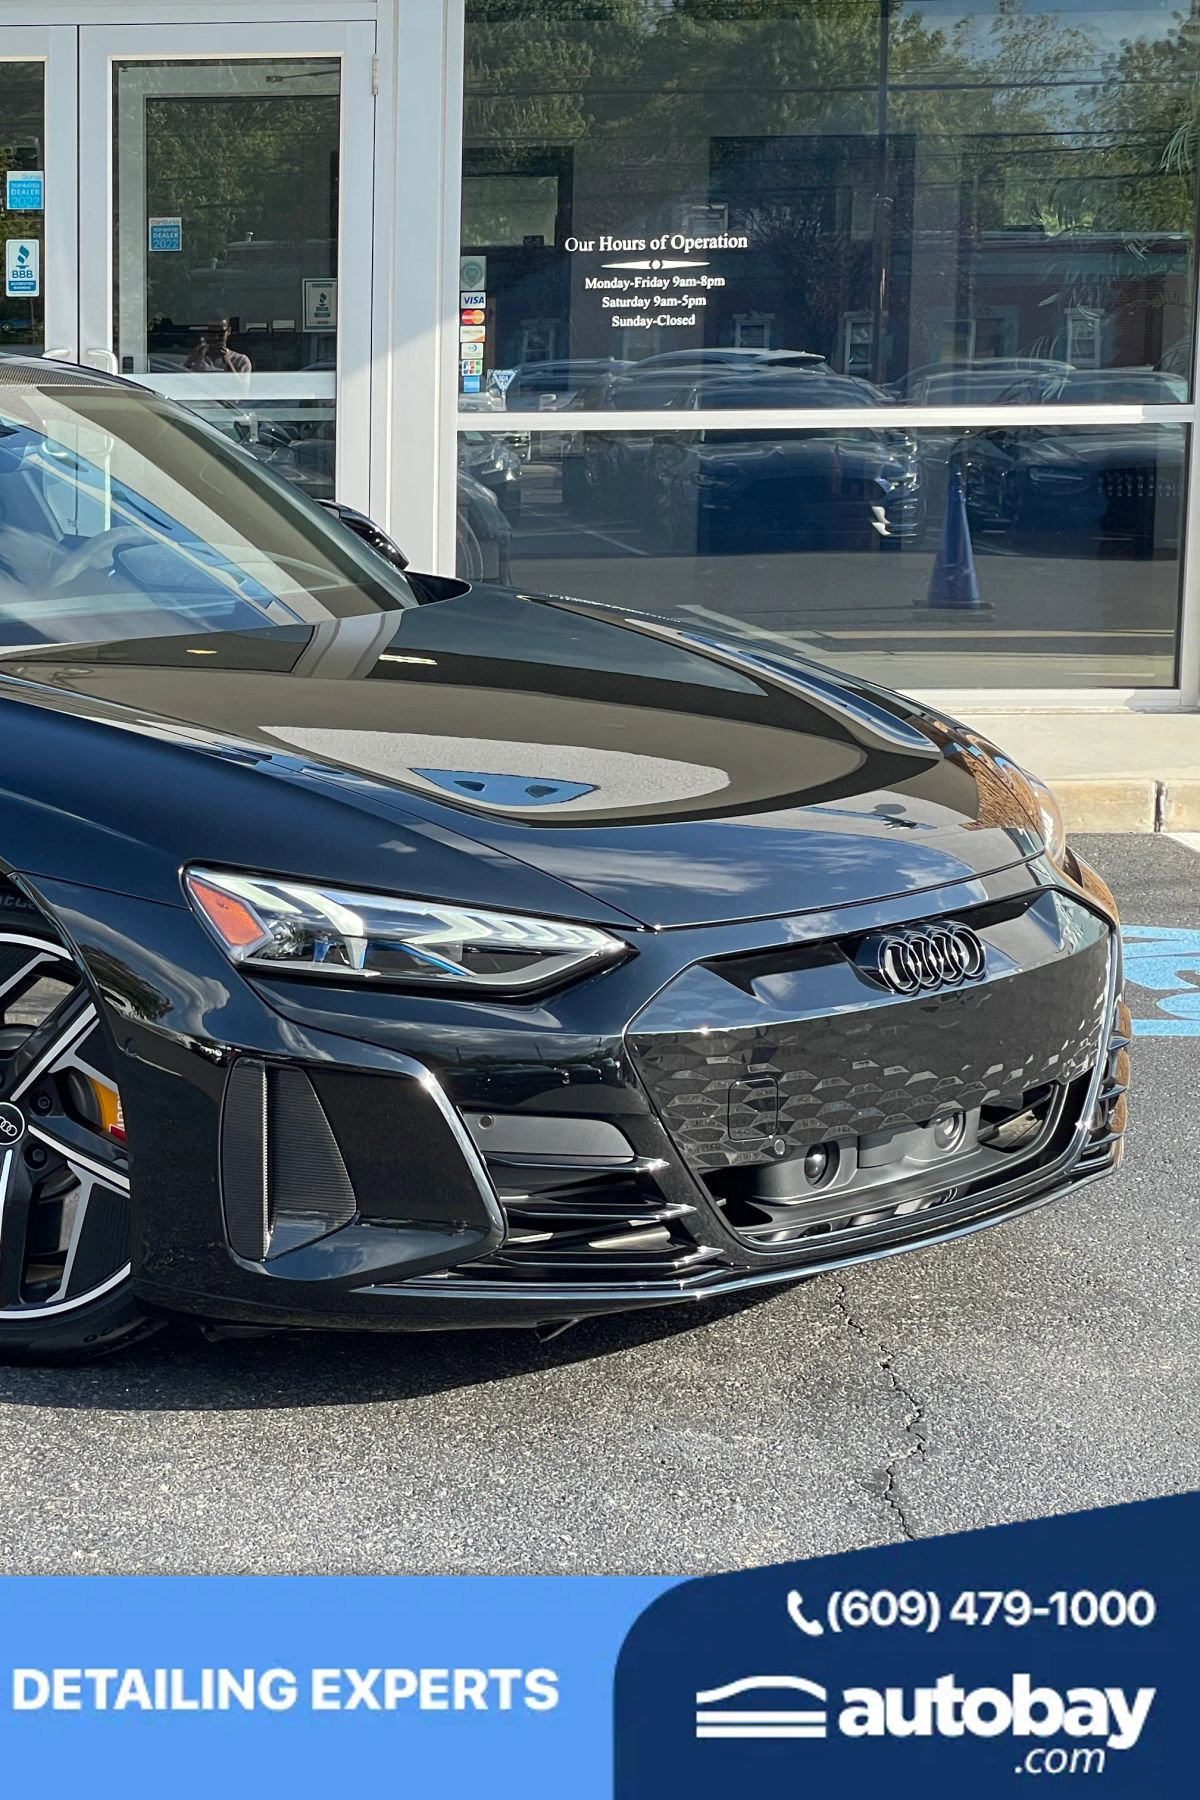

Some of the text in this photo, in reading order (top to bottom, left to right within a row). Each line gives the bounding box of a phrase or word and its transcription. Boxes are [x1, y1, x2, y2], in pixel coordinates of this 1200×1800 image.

[11, 188, 41, 196] DEALER
[11, 196, 41, 208] 2022
[153, 239, 179, 249] 2022
[564, 232, 748, 253] Our Hours of Operation
[12, 270, 33, 279] BBB
[584, 275, 726, 292] Monday-Friday 9am-8pm
[463, 296, 485, 305] VISA
[601, 294, 707, 310] Saturday 9am-5pm
[611, 313, 696, 329] Sunday-Closed
